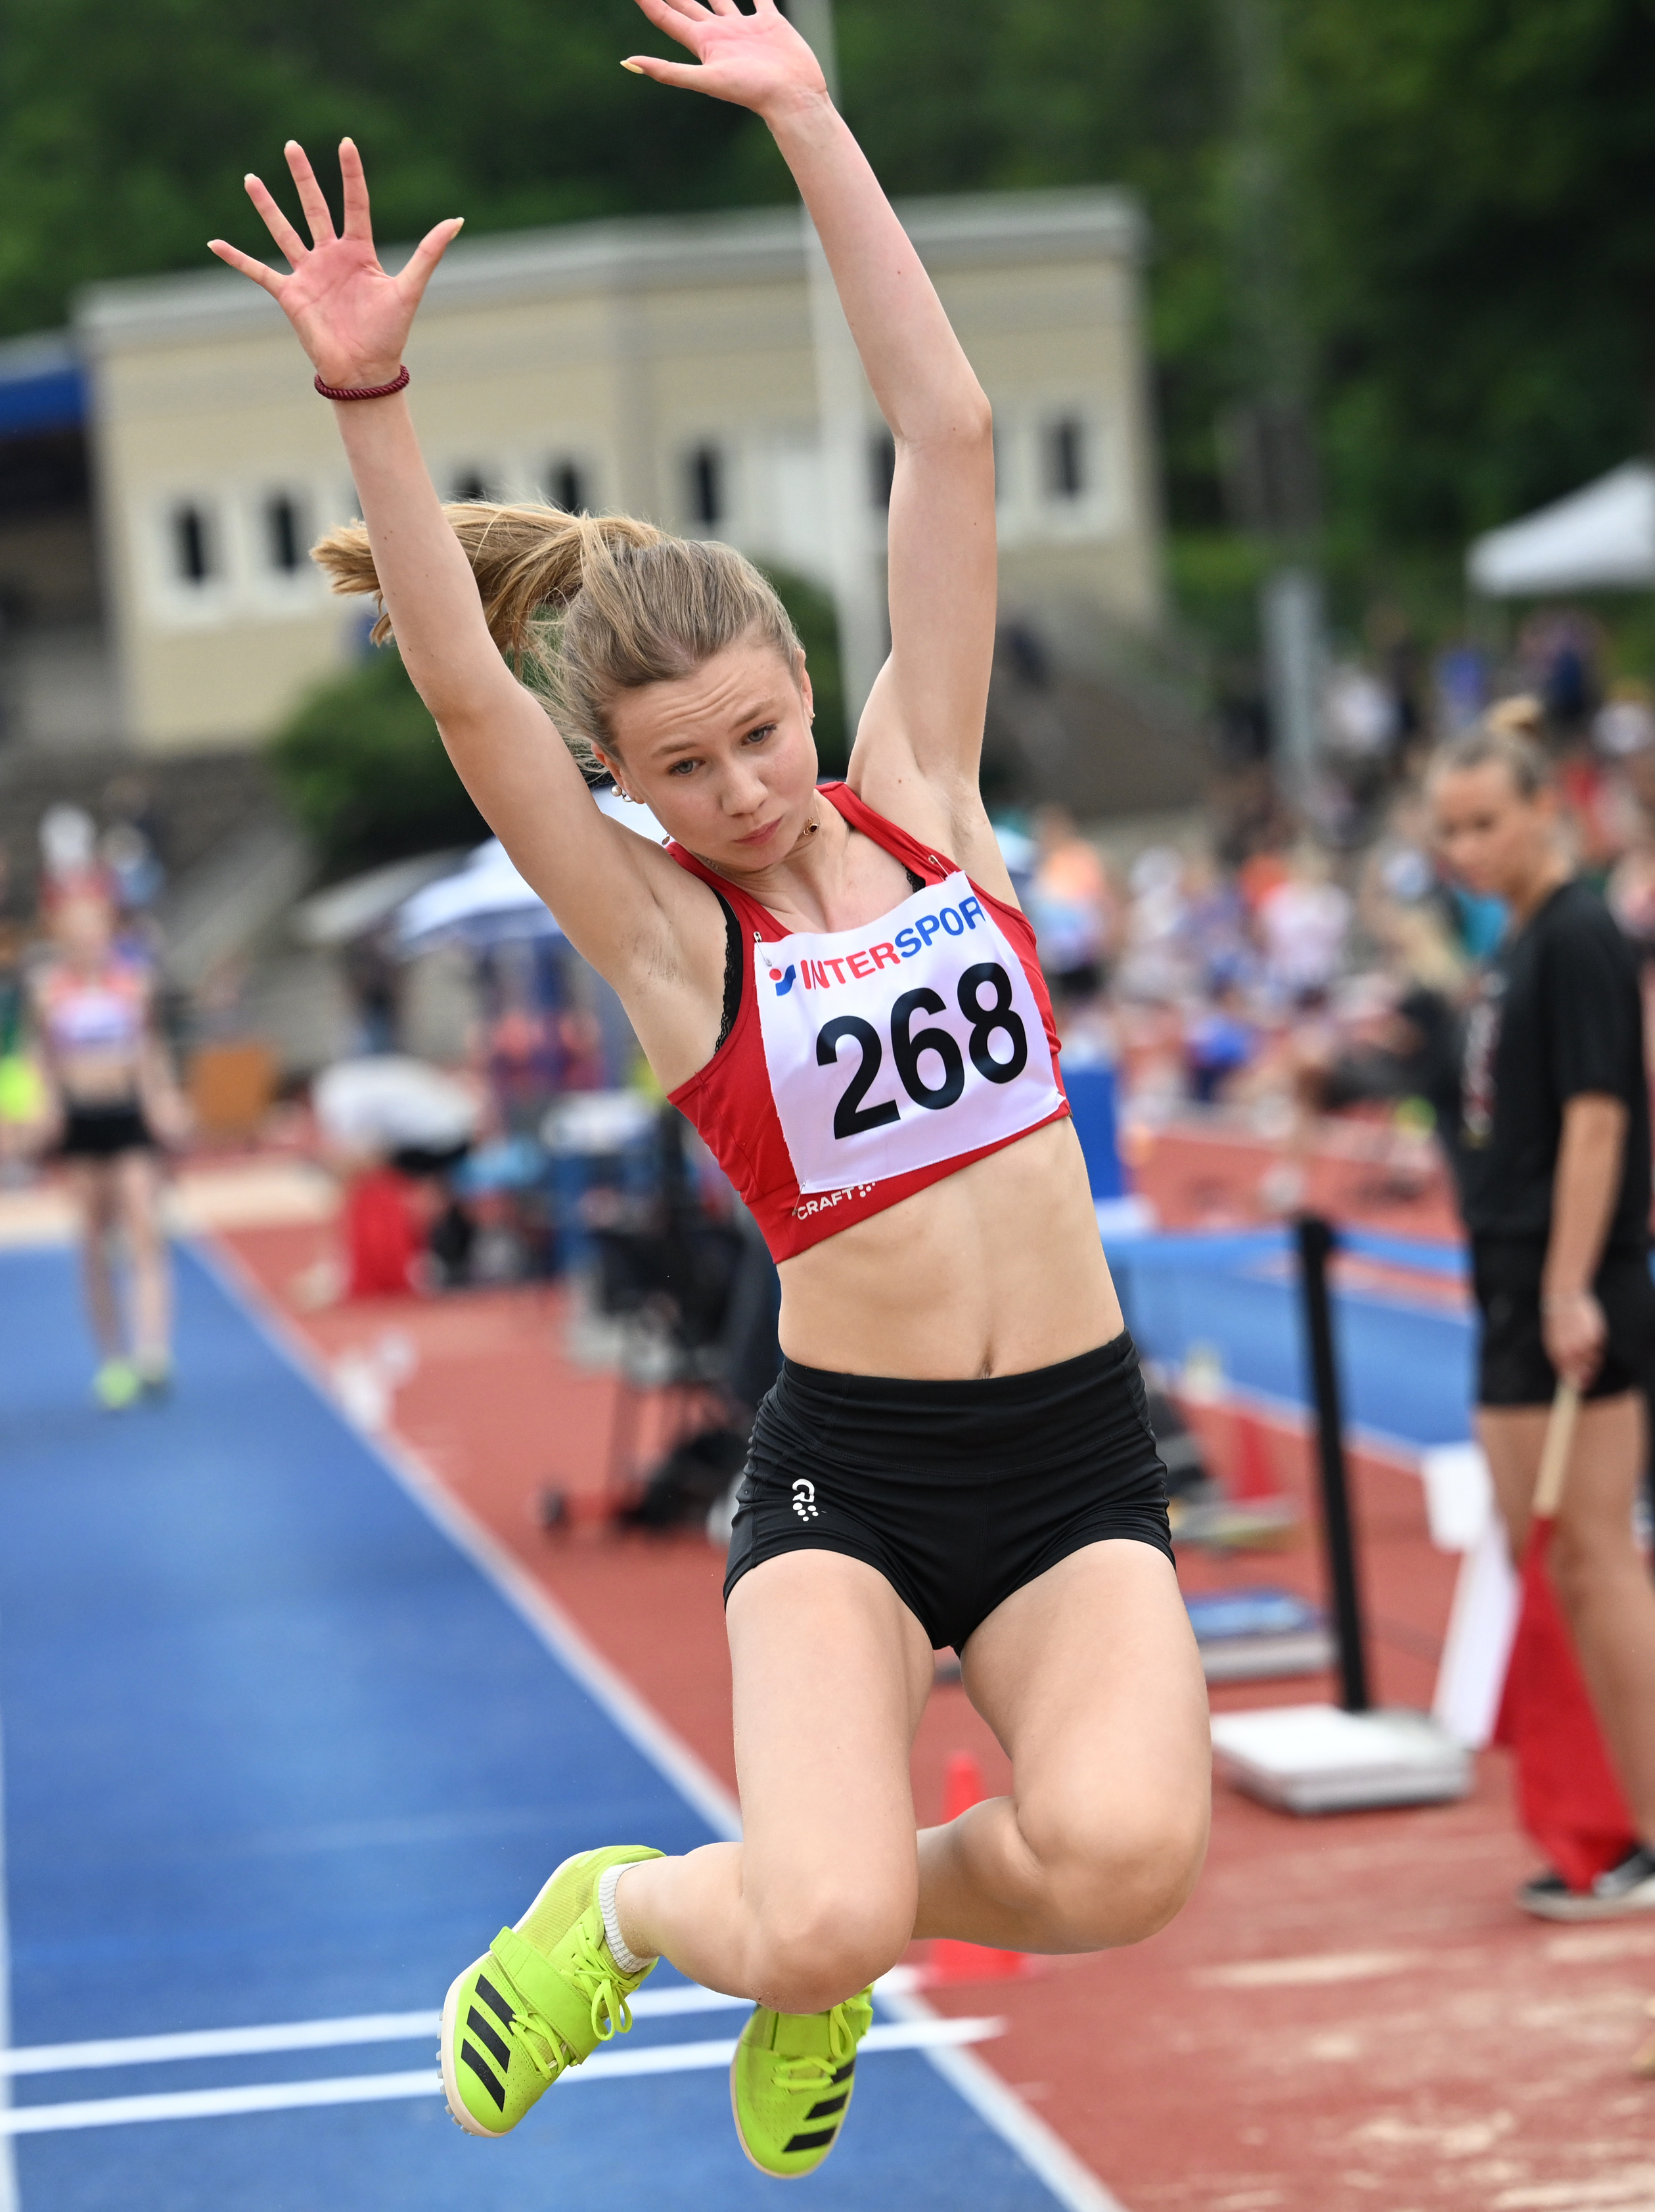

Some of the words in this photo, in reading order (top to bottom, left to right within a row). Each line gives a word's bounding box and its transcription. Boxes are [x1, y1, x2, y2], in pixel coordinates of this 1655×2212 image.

[800, 896, 986, 990] INTERSPOR
[816, 962, 1028, 1140] 268
[797, 1187, 854, 1220] CRAFT
